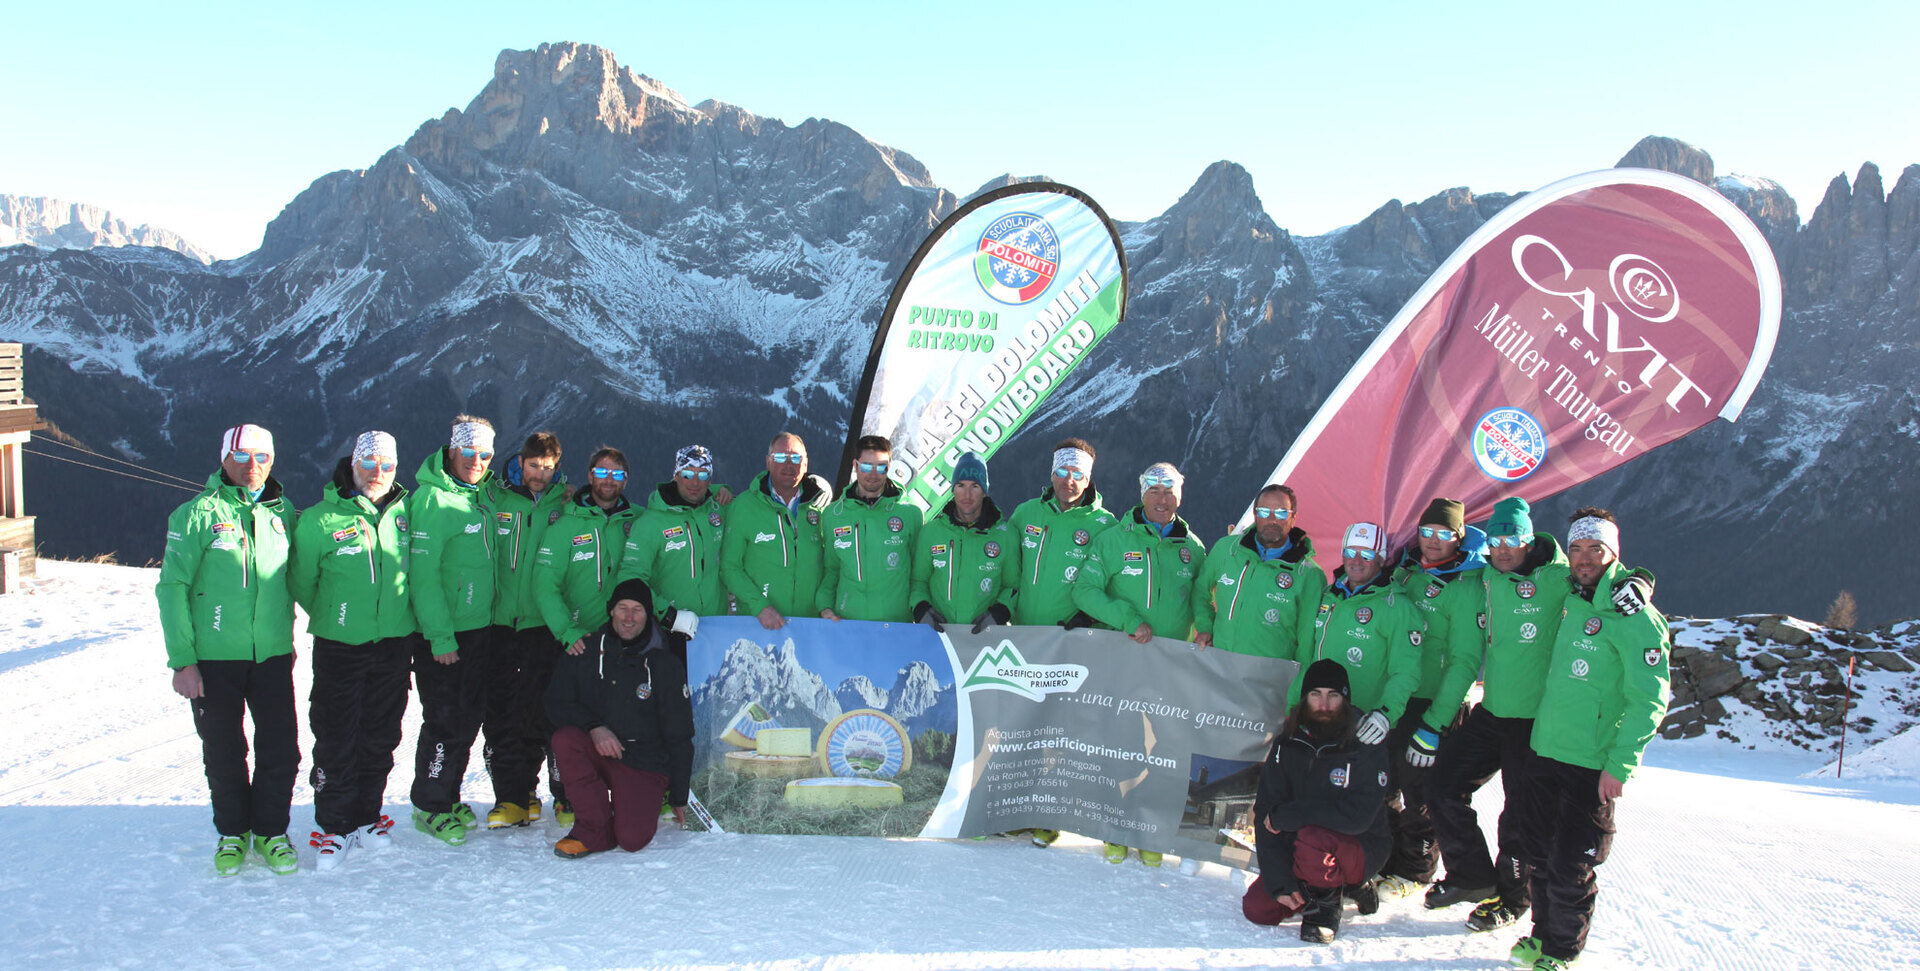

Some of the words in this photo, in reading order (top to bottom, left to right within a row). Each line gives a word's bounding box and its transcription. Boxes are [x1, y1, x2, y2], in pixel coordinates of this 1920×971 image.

[989, 217, 1025, 238] SCUOLA
[1046, 245, 1055, 260] SCI
[984, 241, 1053, 275] DOLOMITI
[908, 305, 973, 328] PUNTO
[977, 310, 998, 331] DI
[1511, 234, 1712, 414] CAVIT
[907, 329, 995, 353] RITROVO
[941, 384, 986, 436] SCI
[980, 269, 1101, 393] DOLOMITI
[1541, 307, 1632, 394] TRENTO
[1474, 302, 1550, 380] Müller
[1544, 363, 1635, 456] Thurgau
[997, 668, 1042, 679] CASEIFICIO
[1044, 670, 1079, 679] SOCIALE
[1030, 679, 1069, 688] PRIMIERO
[1116, 697, 1190, 720] passione
[1194, 712, 1265, 733] genuina
[988, 728, 1031, 741] Acquista
[1033, 725, 1065, 736] online
[428, 742, 445, 779] TRENTINO
[987, 761, 1015, 770] Vienici
[1024, 757, 1056, 766] trovare
[1057, 756, 1066, 764] in
[1068, 758, 1101, 772] negozio
[988, 737, 1177, 769] www.caseificioprimiero.com
[987, 773, 1000, 782] via
[1033, 767, 1049, 776] 179
[1056, 767, 1097, 783] Mezzano
[1098, 776, 1116, 788] (TN)
[997, 783, 1012, 791] +39
[1013, 780, 1035, 789] 0439
[1036, 778, 1069, 788] 765616
[986, 801, 992, 809] e
[1002, 795, 1030, 806] Malga
[1060, 796, 1074, 805] sul
[1076, 798, 1102, 811] Passo
[1103, 803, 1125, 817] Rolle
[1011, 805, 1033, 814] 0439
[1035, 805, 1068, 815] 768659
[1085, 810, 1102, 820] +39
[1120, 819, 1157, 833] 0363019
